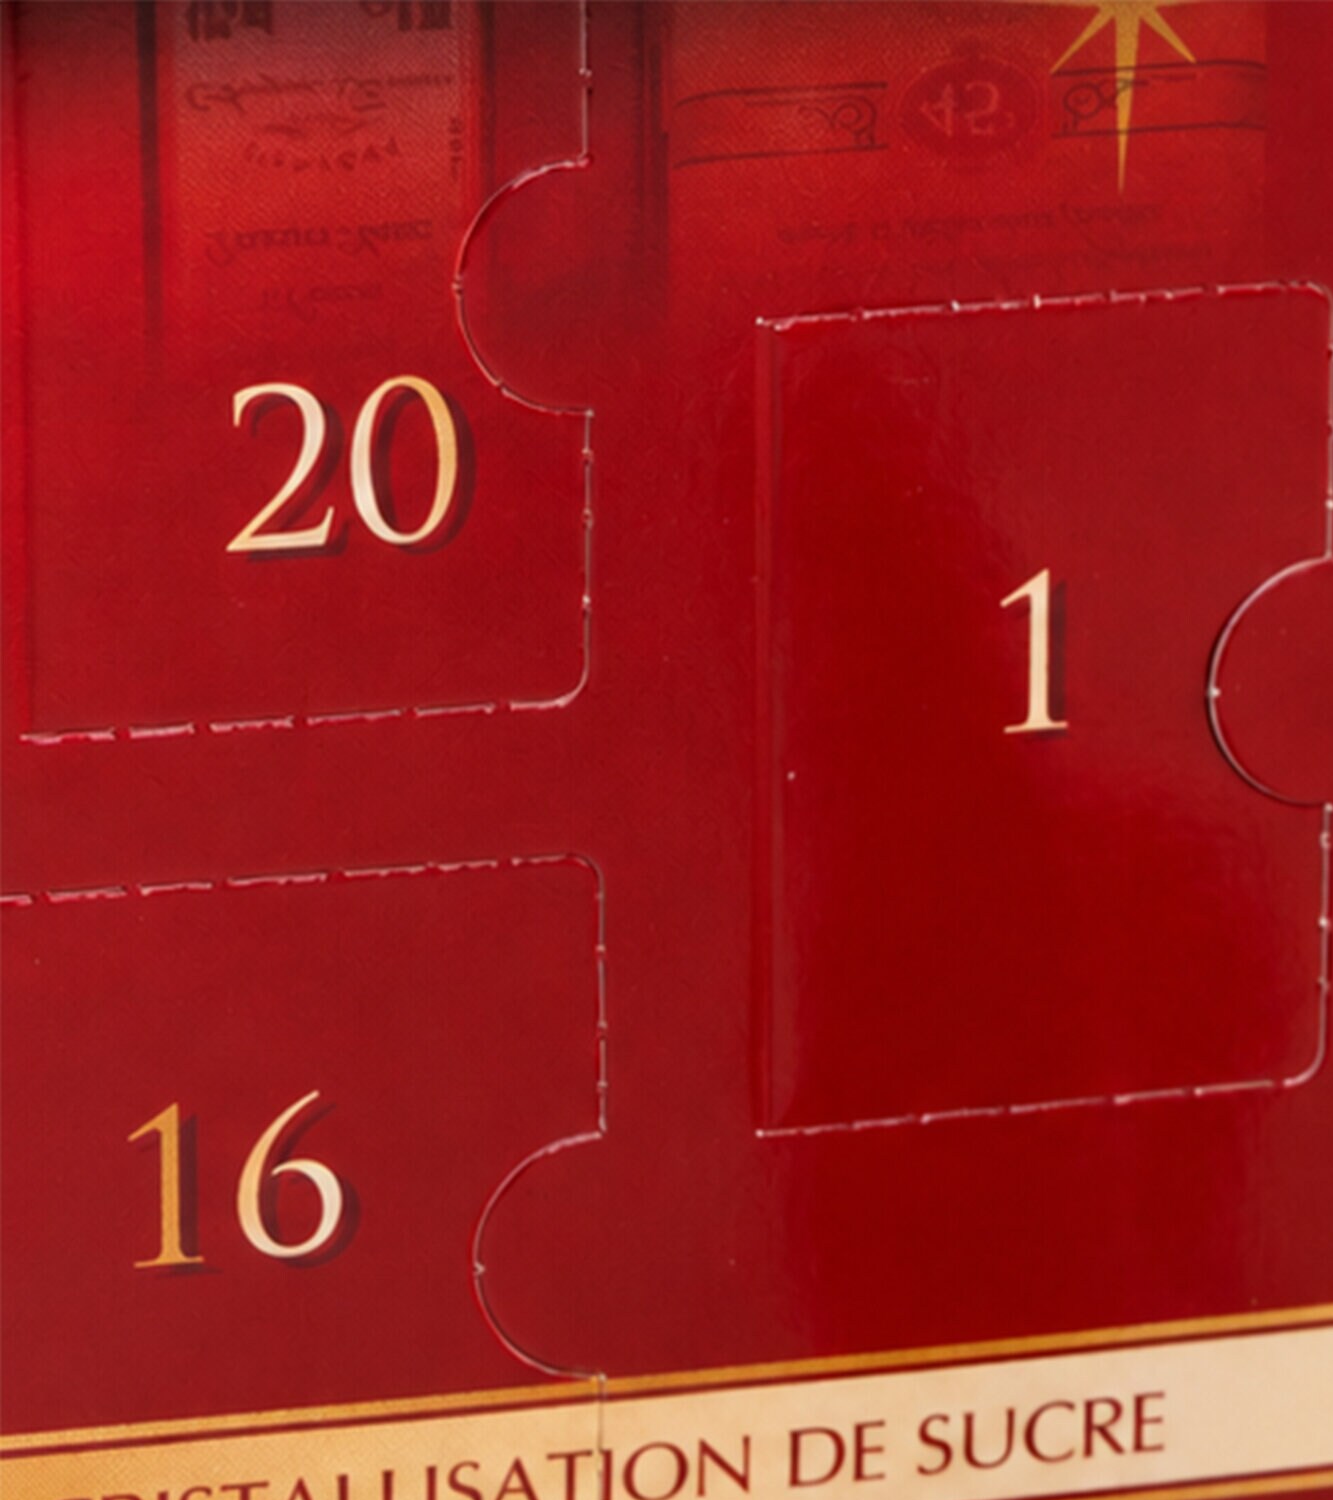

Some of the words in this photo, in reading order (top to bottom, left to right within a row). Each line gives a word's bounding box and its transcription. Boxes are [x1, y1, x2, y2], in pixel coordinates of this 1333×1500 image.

[226, 375, 457, 552] 20
[1000, 567, 1068, 734] 1
[128, 1090, 342, 1269] 16
[788, 1420, 886, 1488] DE
[915, 1391, 1166, 1476] SUCRE
